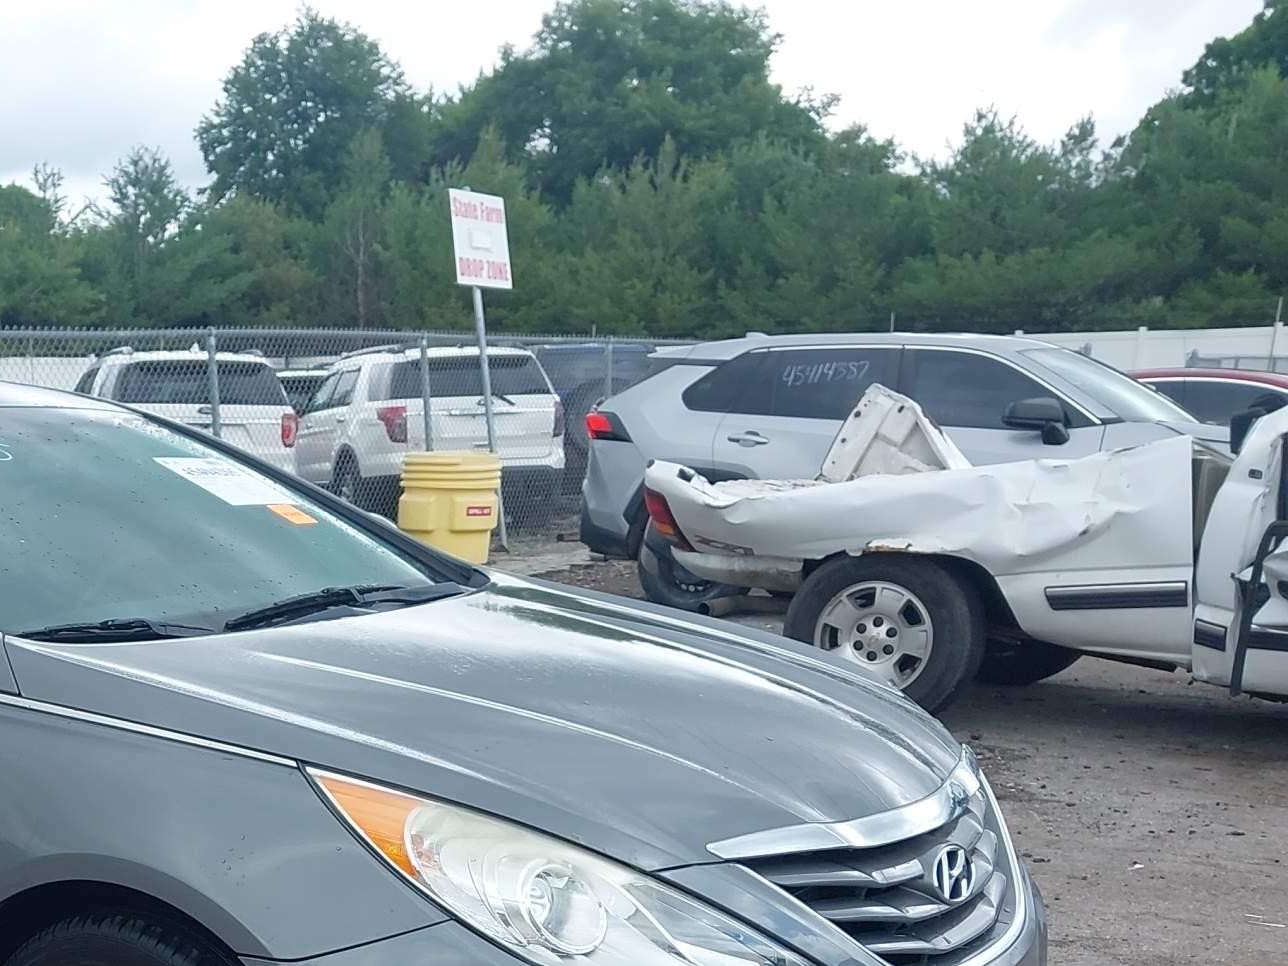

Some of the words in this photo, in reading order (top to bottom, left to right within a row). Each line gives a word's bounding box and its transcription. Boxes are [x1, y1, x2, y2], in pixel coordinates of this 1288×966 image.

[453, 196, 479, 220] State
[480, 201, 504, 224] Farm
[459, 257, 484, 278] DROP
[486, 260, 509, 281] ZONE
